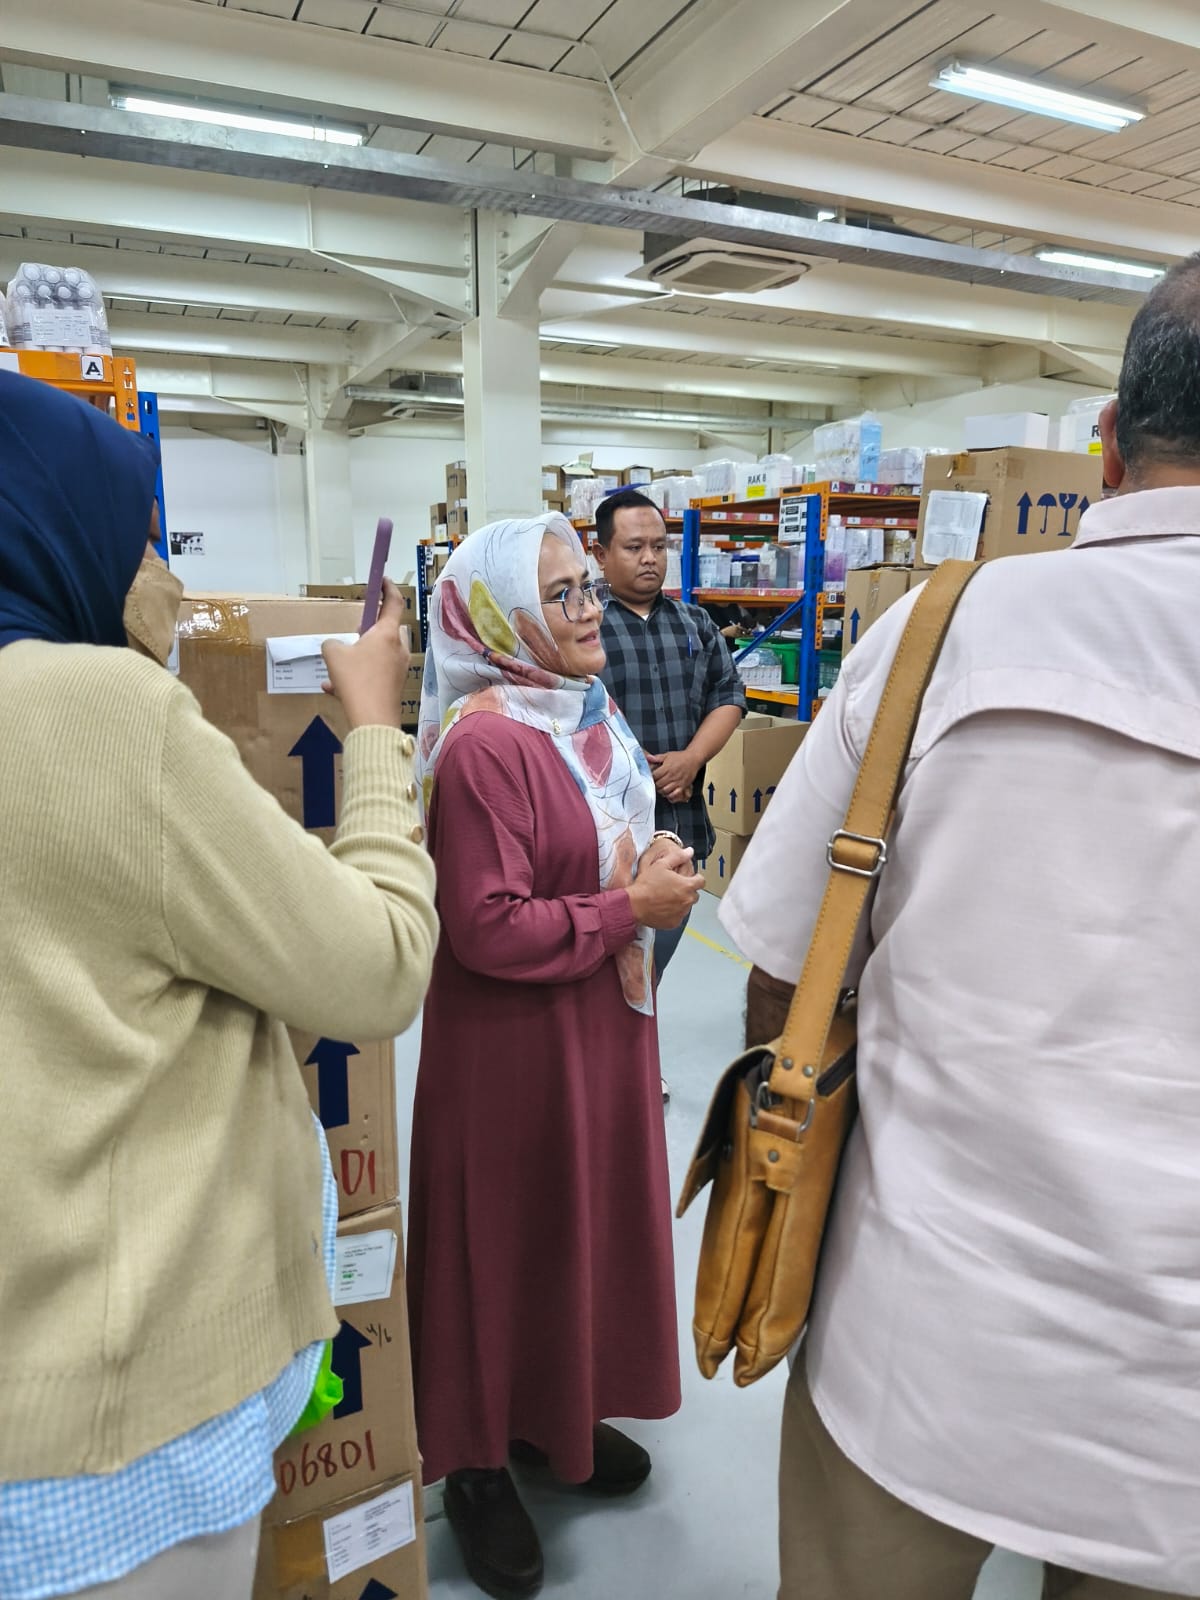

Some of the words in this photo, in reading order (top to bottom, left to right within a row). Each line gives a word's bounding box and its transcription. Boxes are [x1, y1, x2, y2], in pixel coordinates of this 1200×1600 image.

[86, 362, 101, 376] A
[1091, 424, 1100, 438] R
[747, 473, 761, 485] RAK
[832, 482, 839, 490] A
[334, 1148, 376, 1196] 01
